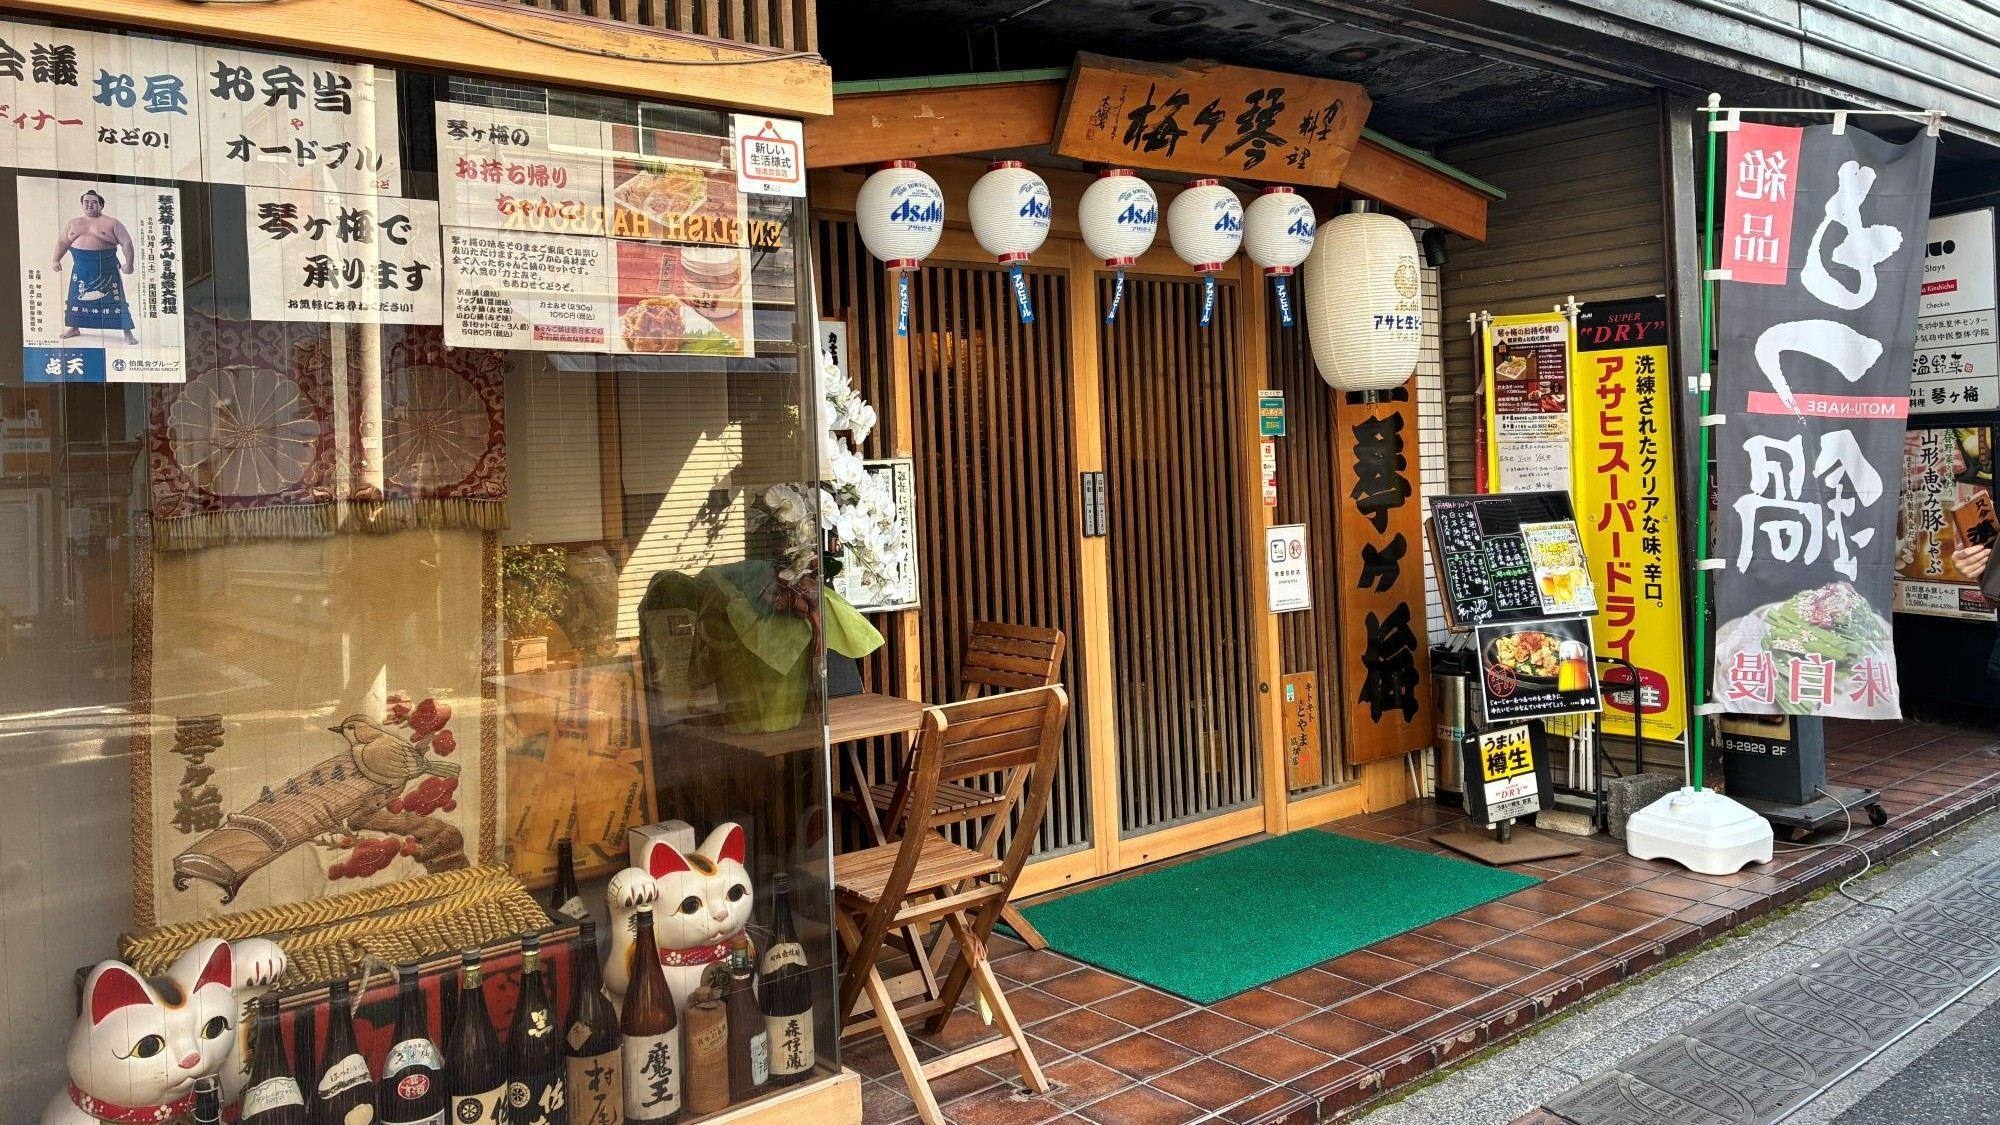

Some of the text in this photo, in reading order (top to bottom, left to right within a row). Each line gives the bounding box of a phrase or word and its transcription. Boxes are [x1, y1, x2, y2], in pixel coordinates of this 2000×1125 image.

[92, 69, 188, 116] お昼
[210, 60, 353, 115] お弁当
[290, 118, 304, 130] や
[97, 126, 170, 149] などの!
[755, 143, 785, 155] 新しい
[226, 134, 383, 172] オードブル
[751, 154, 792, 169] 生活様式
[456, 157, 568, 188] お持ち帰り
[496, 193, 586, 221] ちゃんこ!
[303, 254, 432, 292] 承ります
[1925, 264, 1946, 273] Stays
[502, 279, 576, 293] もあわせてどうぞ。
[1373, 315, 1422, 330] アサヒ生ビ
[1608, 312, 1641, 323] SUPER
[46, 358, 84, 375] 点天
[1912, 351, 1963, 376] 温野菜
[1910, 388, 1925, 397] 力士
[1910, 398, 1926, 408] 料理
[1635, 355, 1664, 609] 洗練されたクリアな味、辛口。
[1596, 355, 1637, 662] アサヒスーパードライ
[1920, 429, 1946, 574] 山形恵み豚しゃぶ
[1304, 682, 1314, 723] キトキト
[1297, 704, 1308, 747] とやま
[1484, 730, 1526, 753] うまい!
[1772, 746, 1787, 756] 2F
[1486, 748, 1530, 777] 樽生
[640, 1041, 674, 1108] 魔王
[529, 1077, 566, 1125] 佐
